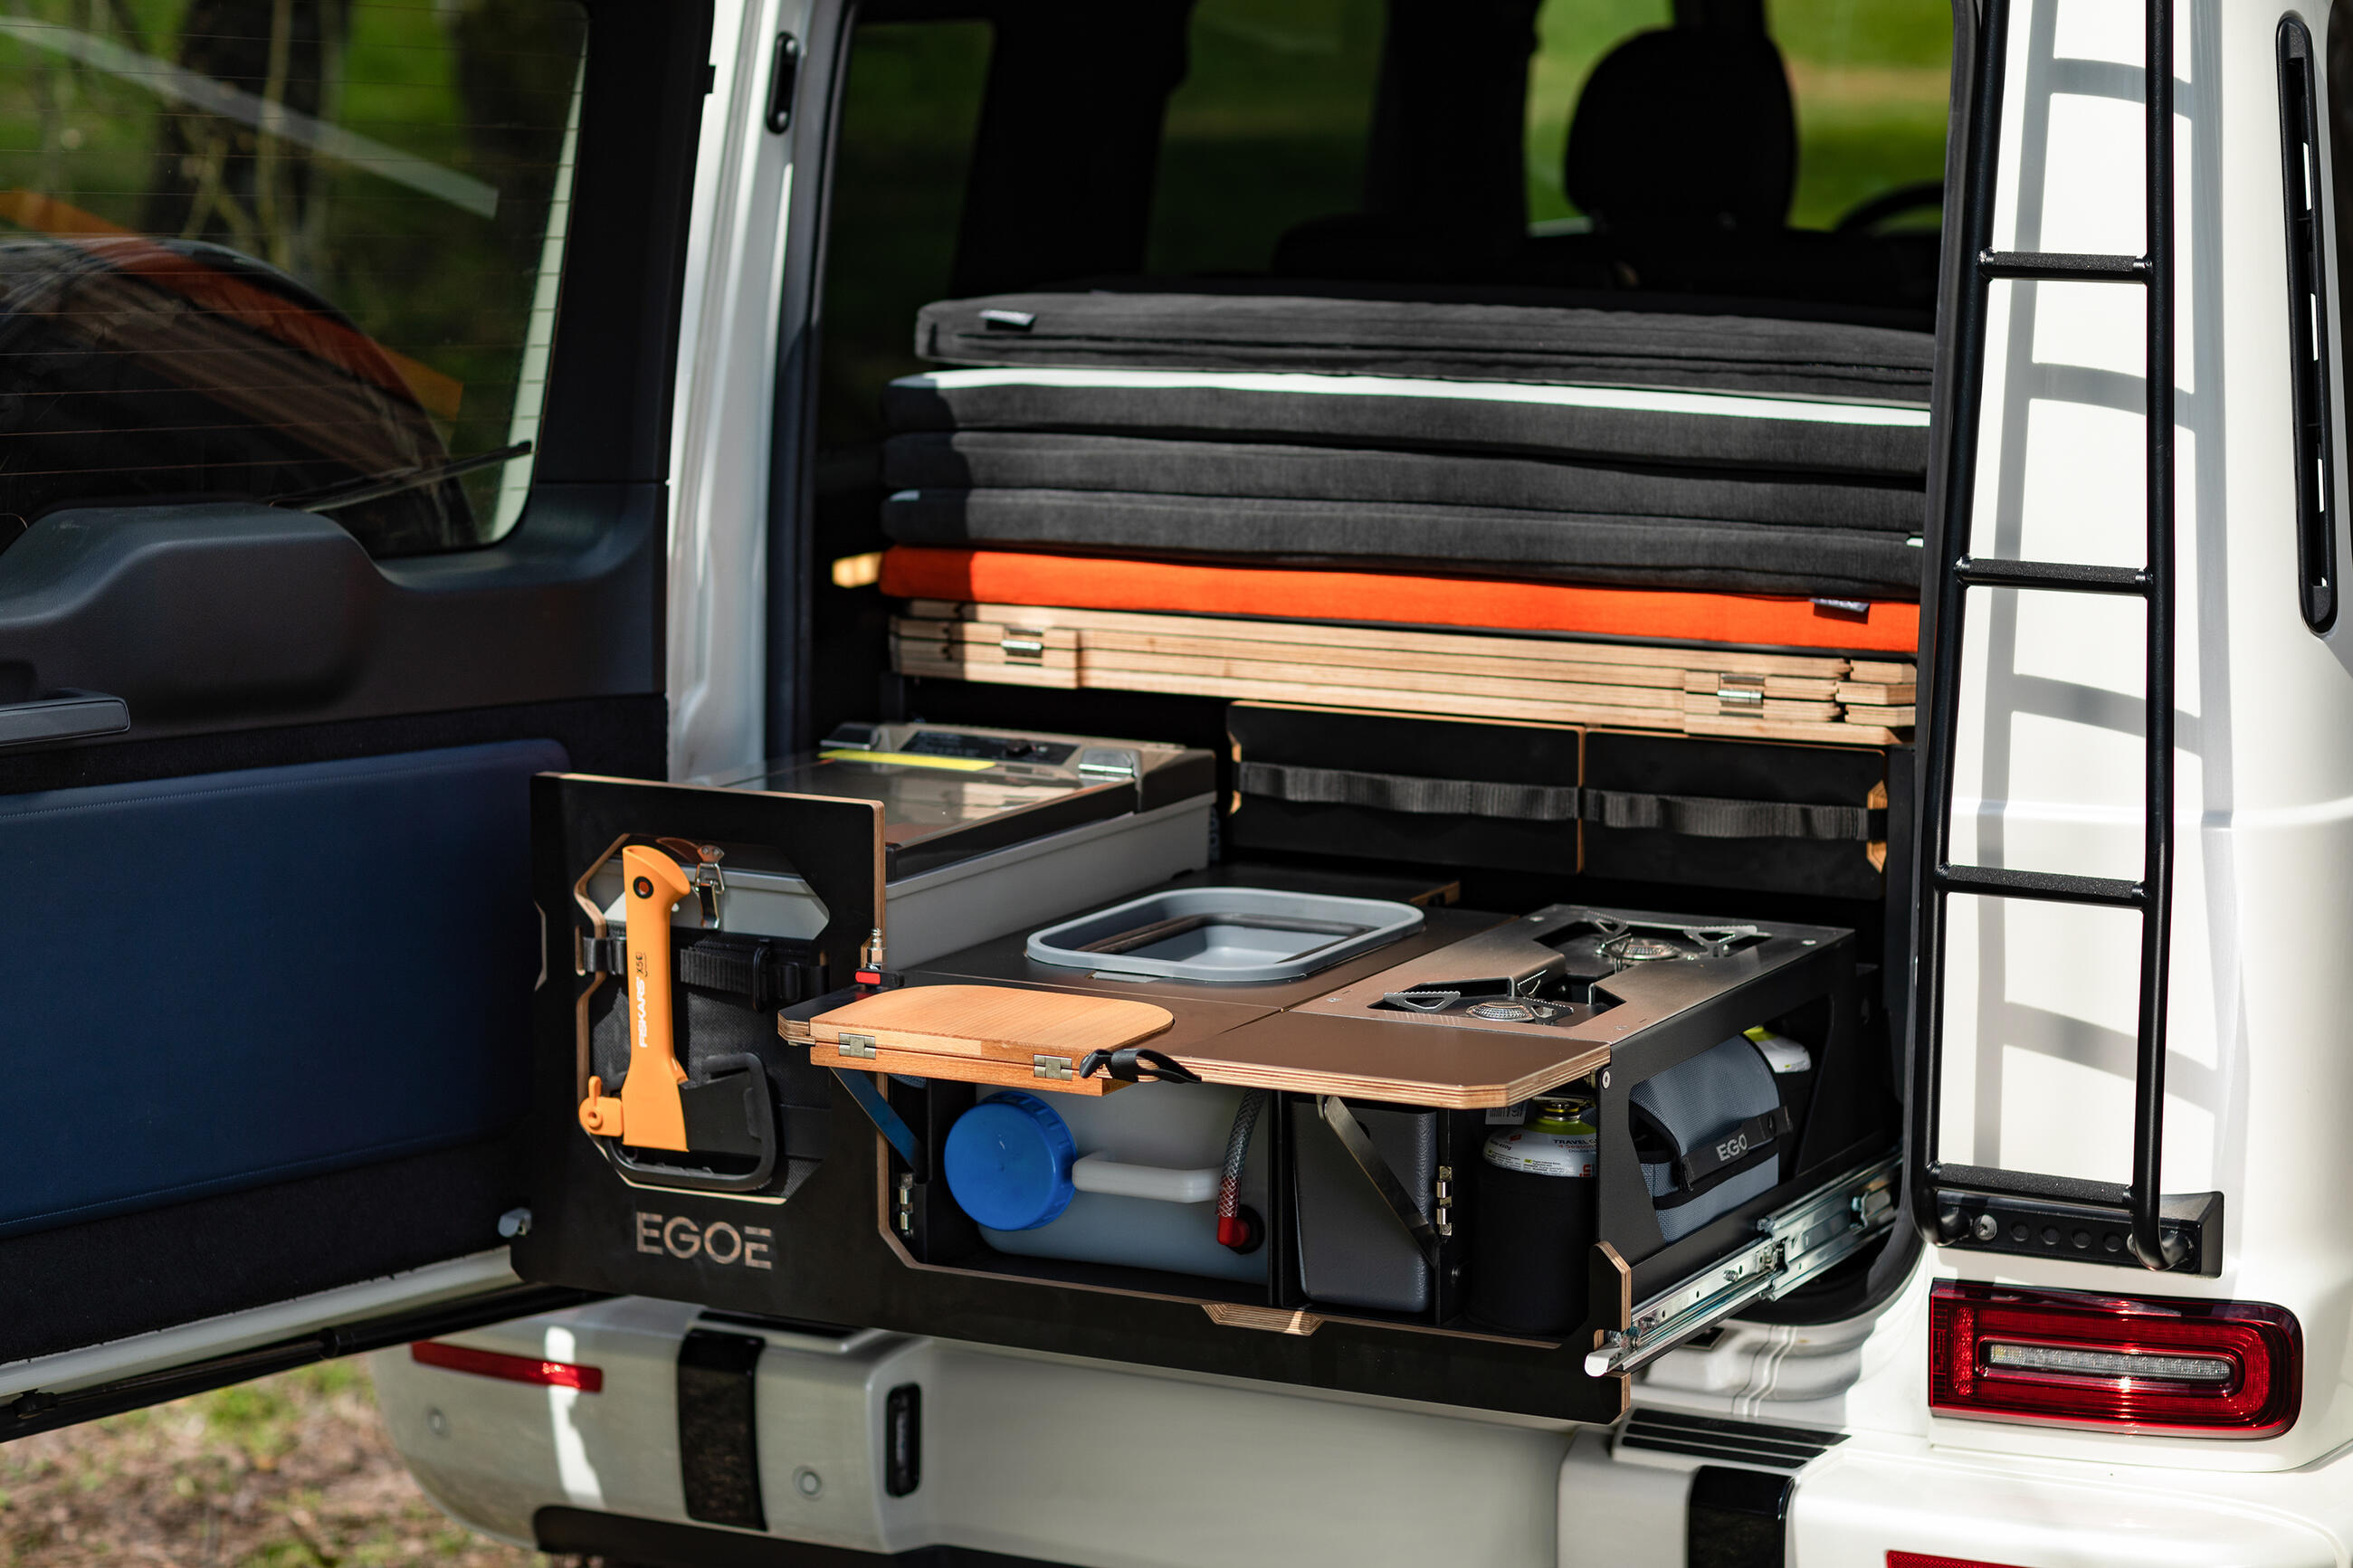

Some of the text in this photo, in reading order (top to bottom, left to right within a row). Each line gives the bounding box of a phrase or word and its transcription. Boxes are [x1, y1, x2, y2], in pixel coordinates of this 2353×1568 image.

[636, 976, 647, 1048] FISKARS
[1716, 1133, 1748, 1161] EGO
[636, 1211, 772, 1270] EGOE
